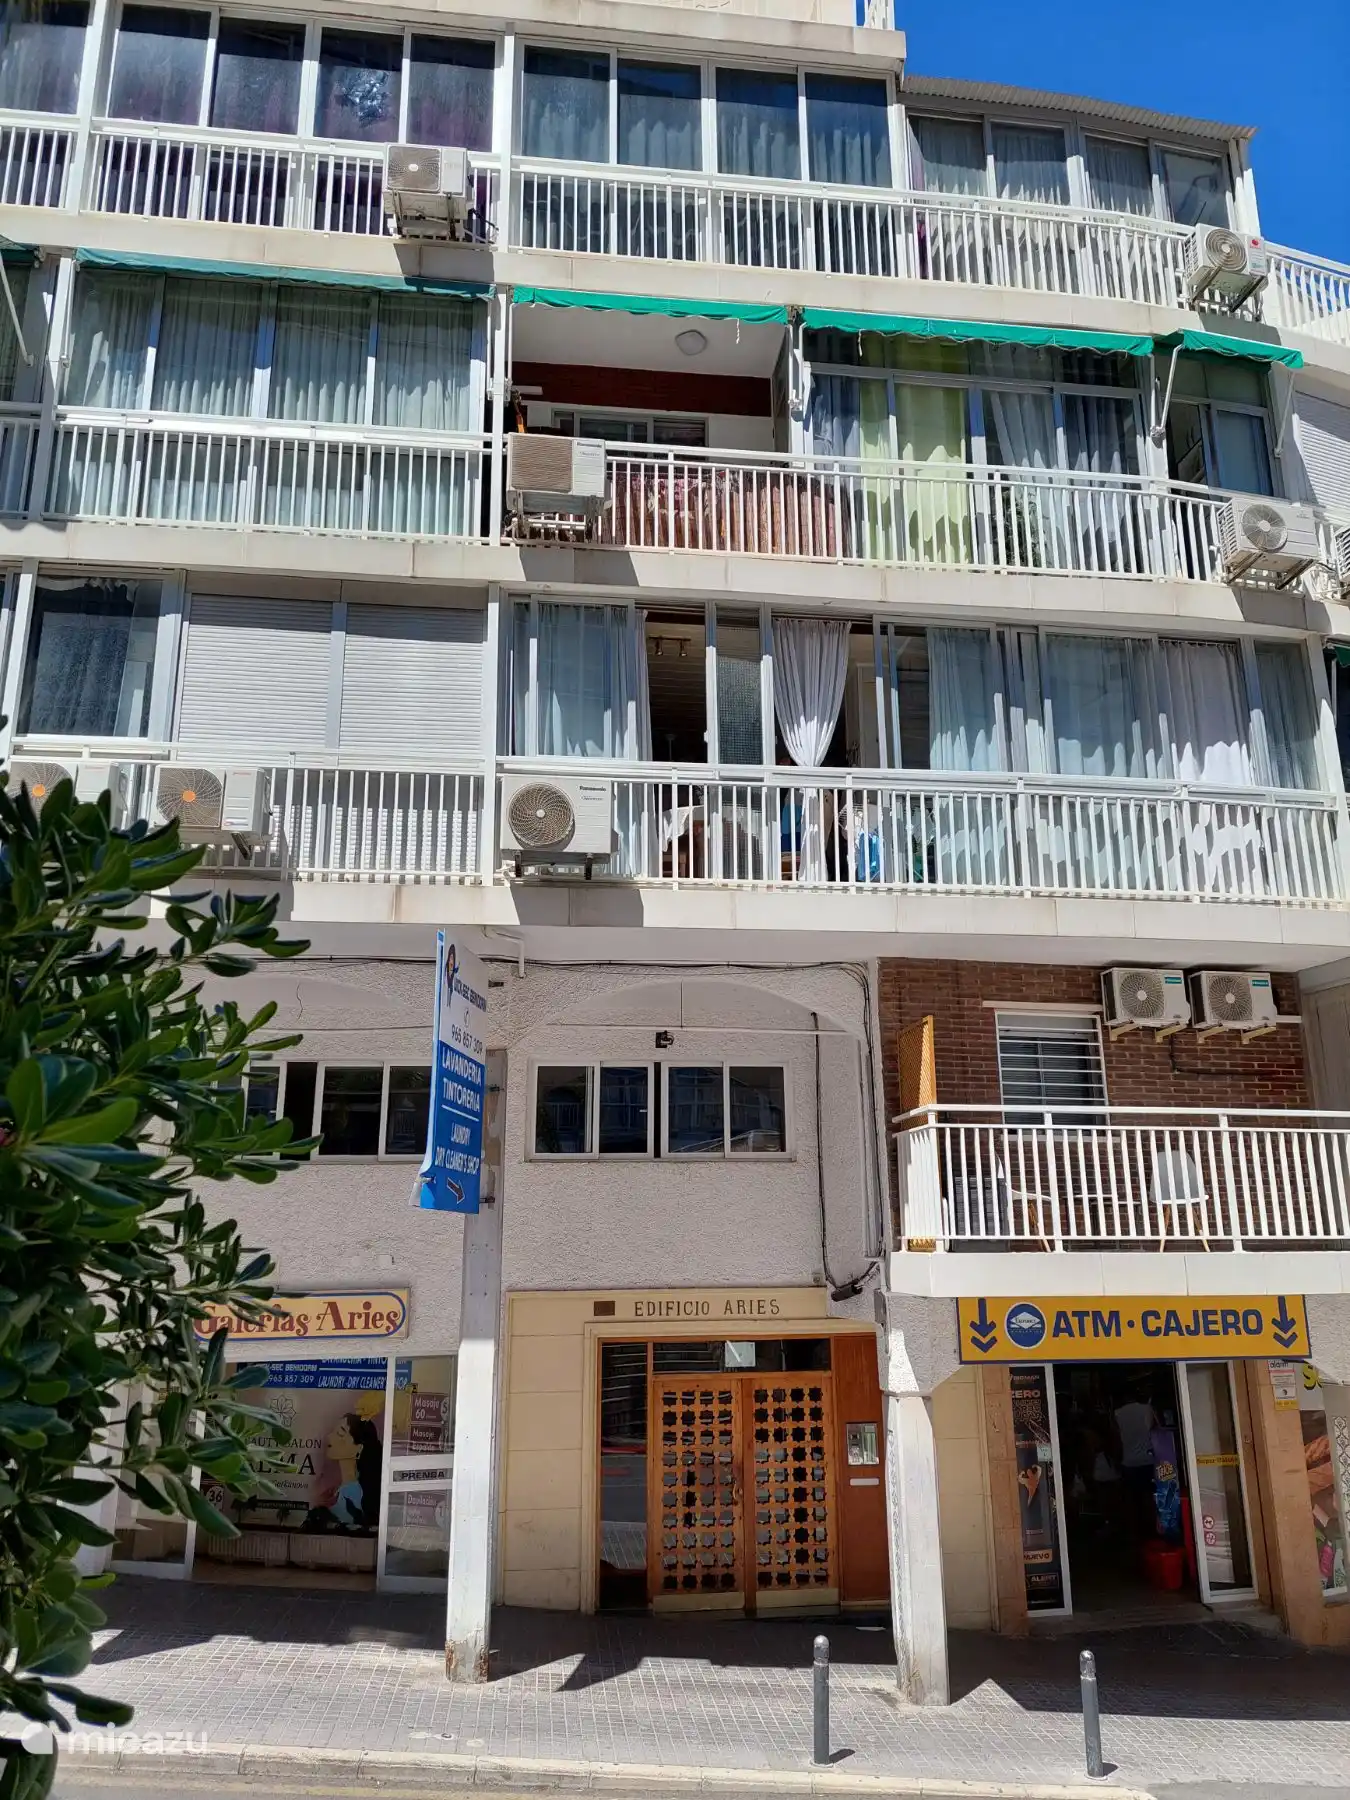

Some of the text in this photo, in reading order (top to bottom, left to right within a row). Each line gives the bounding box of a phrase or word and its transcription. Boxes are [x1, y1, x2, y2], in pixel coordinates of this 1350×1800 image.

[452, 1024, 462, 1043] 965
[443, 1077, 480, 1112] TINTORERIA
[316, 1301, 401, 1333] Aries
[634, 1299, 780, 1316] EDIFICIO ARIES
[1052, 1309, 1262, 1338] ATM CAJERO
[300, 1375, 315, 1383] 309
